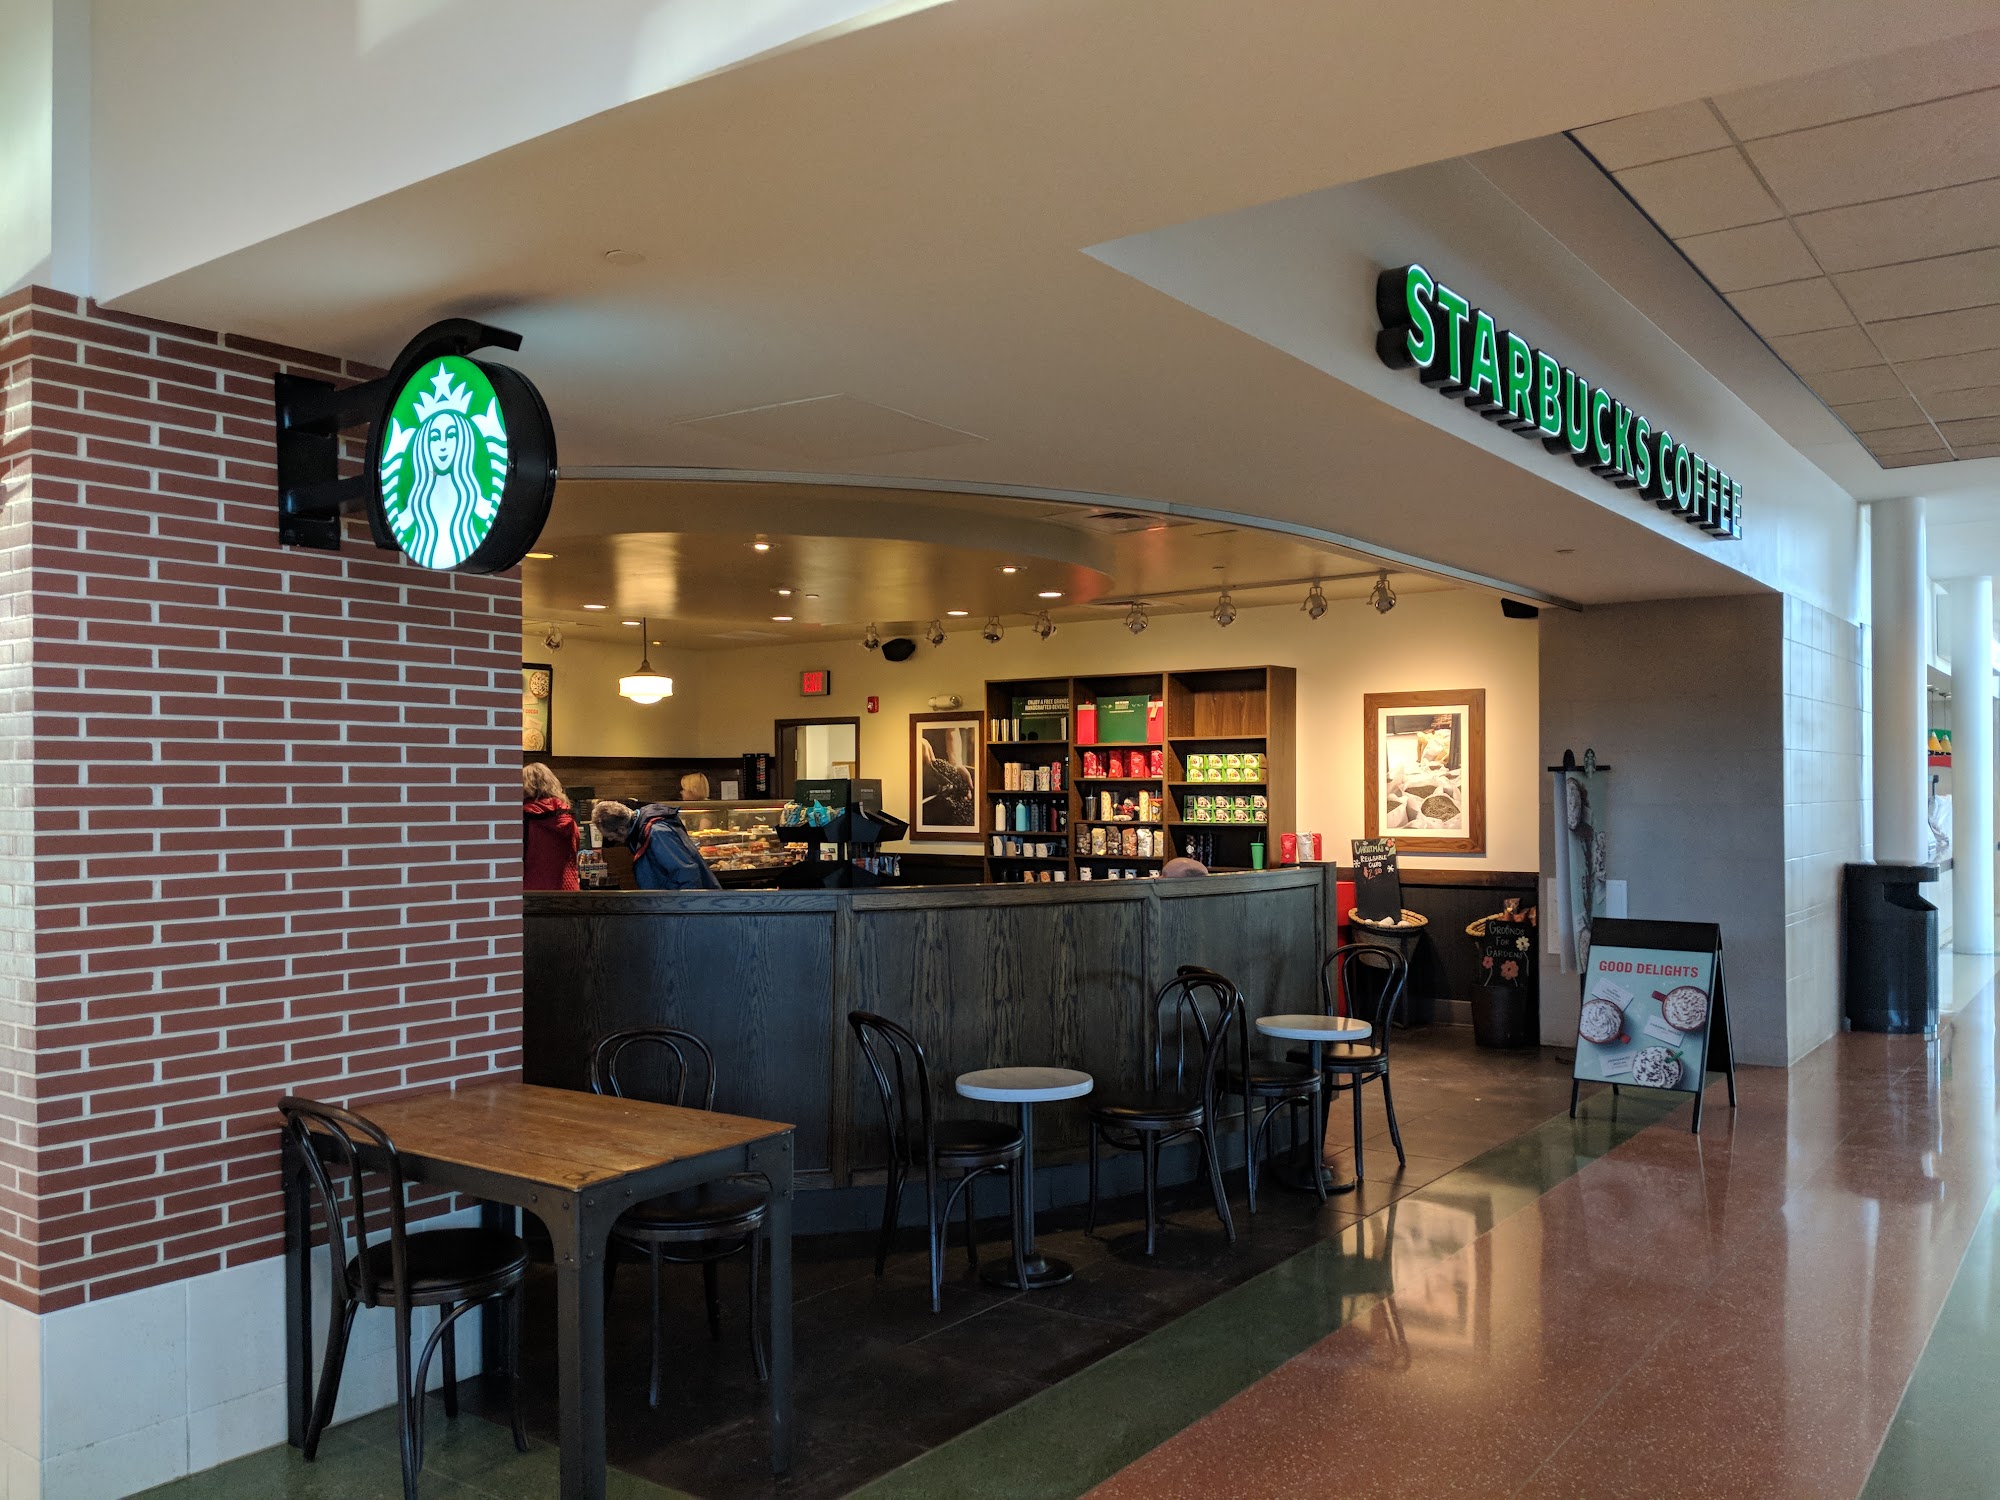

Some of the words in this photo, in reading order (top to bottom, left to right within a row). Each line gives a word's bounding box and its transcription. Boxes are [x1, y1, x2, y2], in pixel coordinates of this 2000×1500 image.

[1405, 264, 1652, 488] STARBUCKS
[1658, 430, 1742, 541] COFFEE
[1488, 920, 1525, 936] GROUNDS
[1495, 936, 1510, 946] FOR
[1486, 945, 1524, 959] GARDENS
[1599, 960, 1633, 974] GOOD
[1636, 963, 1699, 978] DELIGHTS
